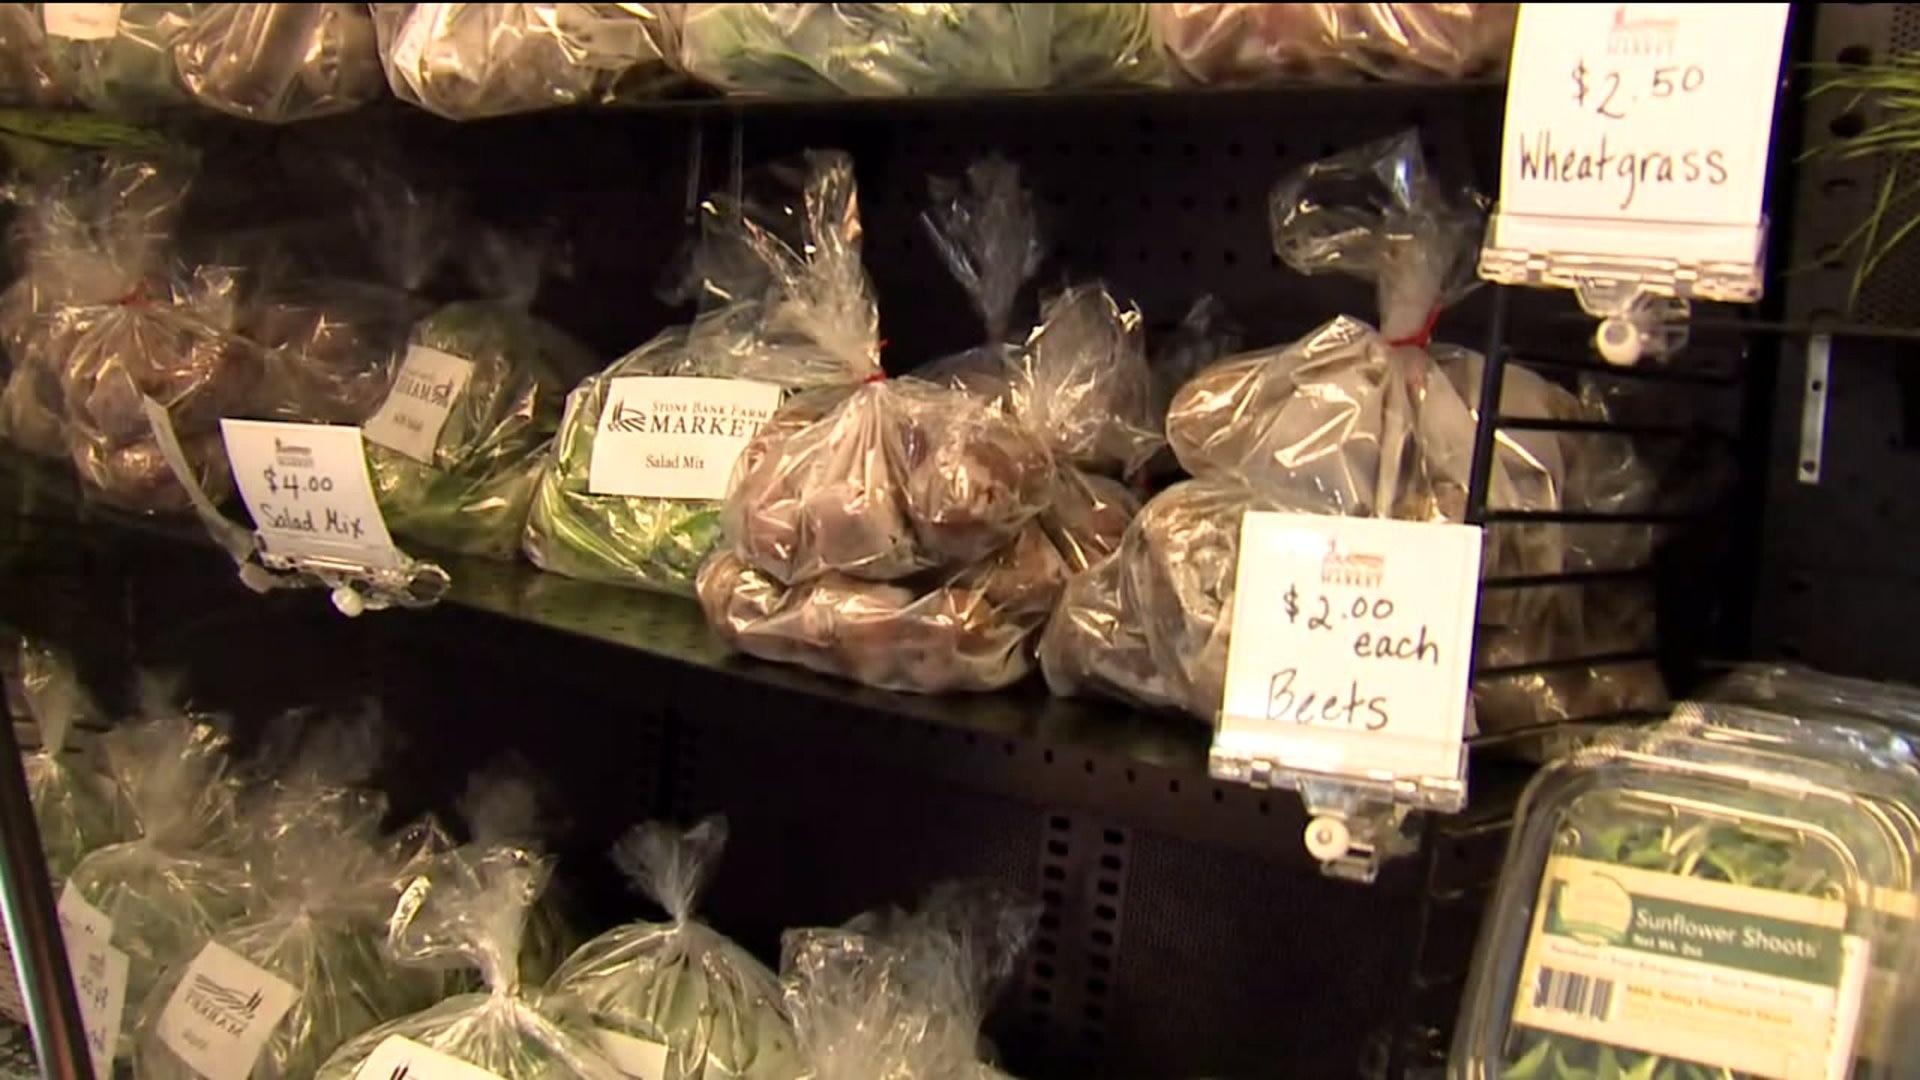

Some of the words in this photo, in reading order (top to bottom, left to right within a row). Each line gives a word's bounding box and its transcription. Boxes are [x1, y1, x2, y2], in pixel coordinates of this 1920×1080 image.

[1571, 59, 1704, 119] $2.50
[1520, 130, 1728, 210] Wheatgrass
[651, 413, 766, 438] MARKET
[646, 455, 680, 469] Salad
[264, 466, 333, 500] $4.00
[260, 503, 317, 533] Salad
[325, 507, 365, 539] Mix
[1283, 584, 1395, 631] $2.00
[1353, 625, 1439, 666] each
[1266, 668, 1389, 731] Beets
[1635, 908, 1736, 945] Sunflower
